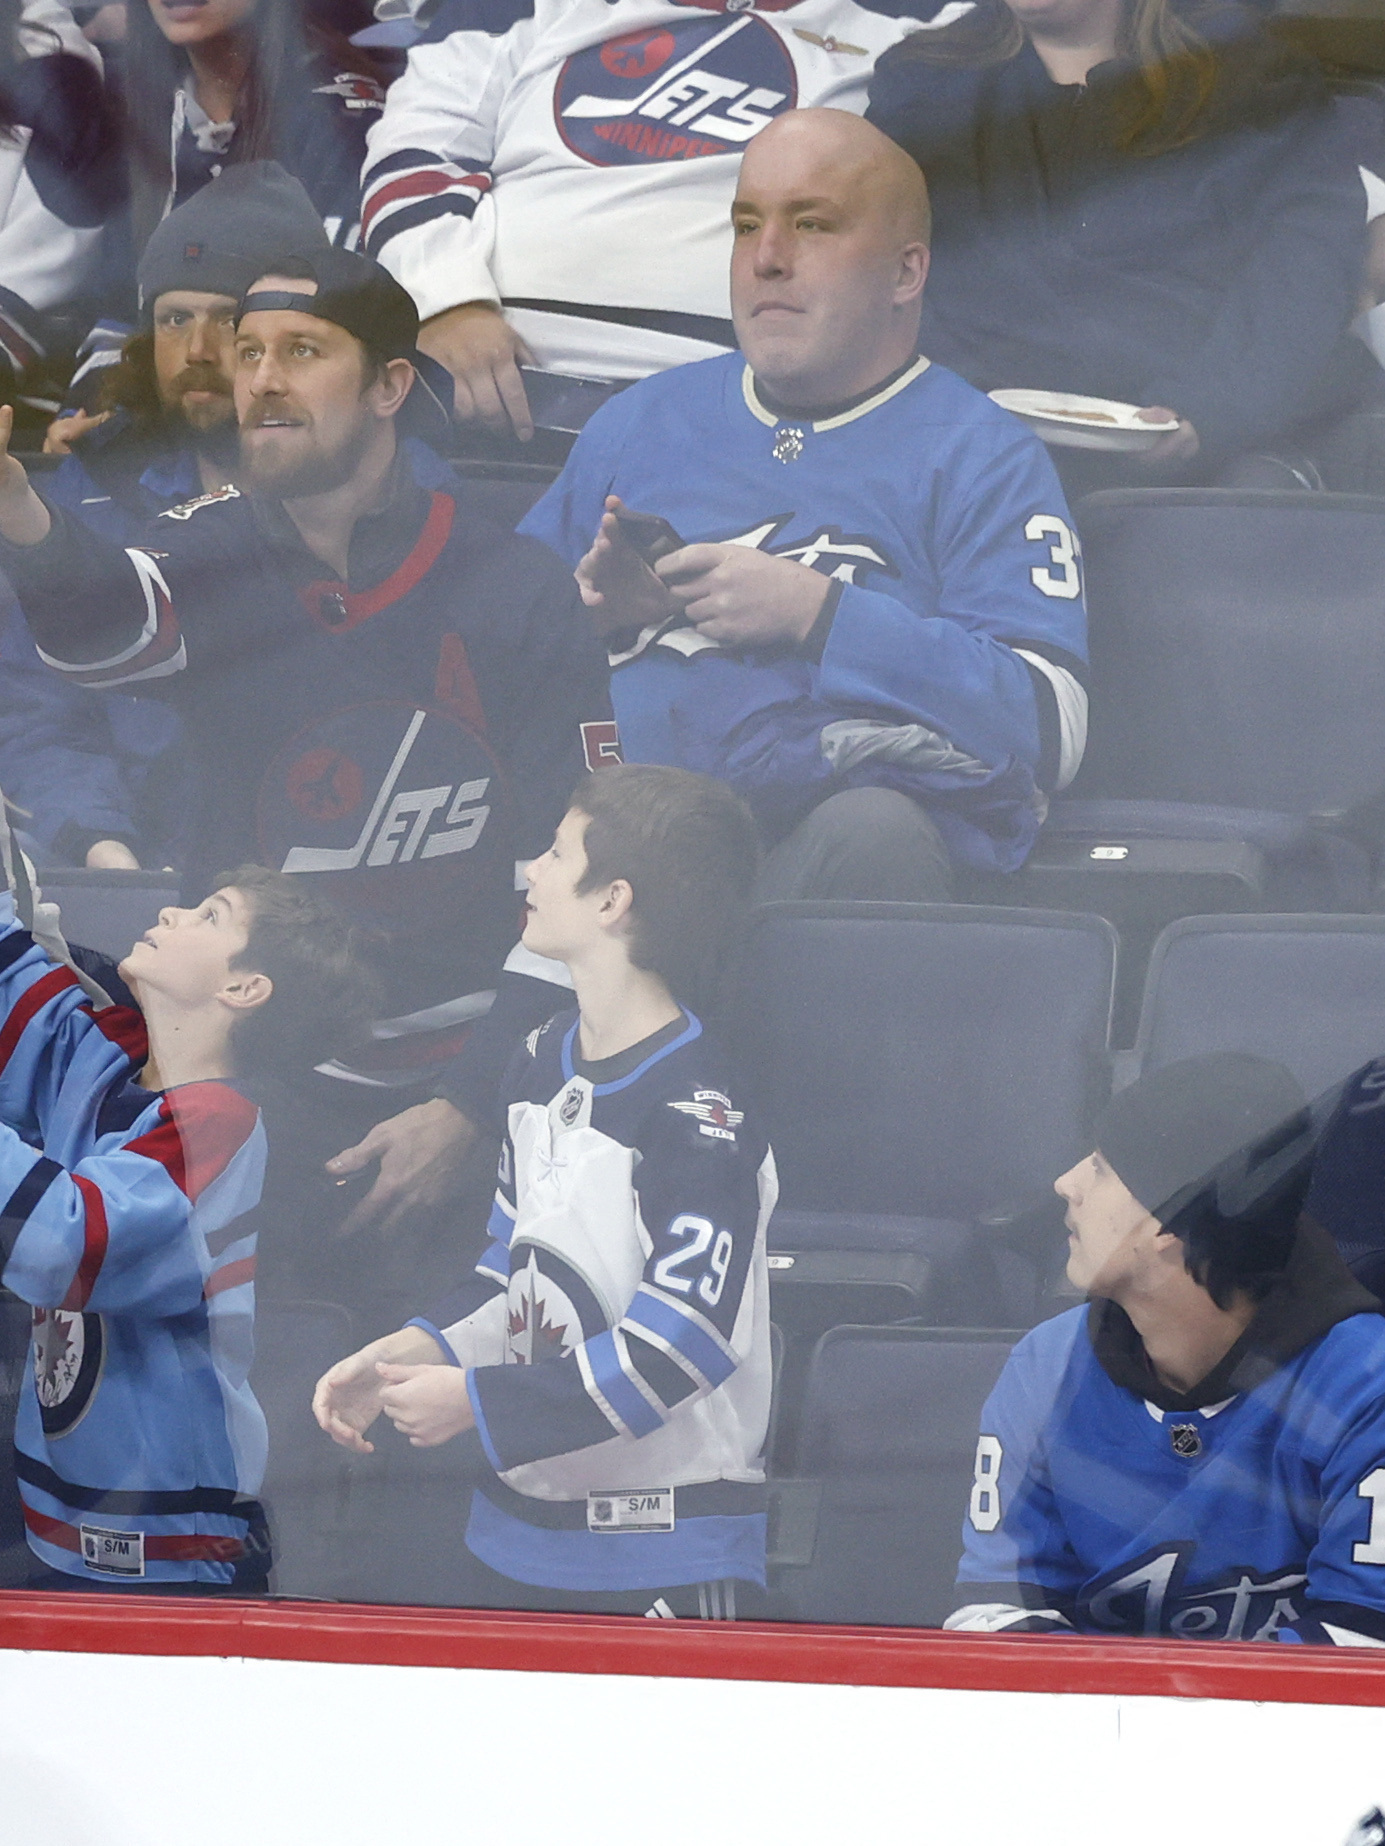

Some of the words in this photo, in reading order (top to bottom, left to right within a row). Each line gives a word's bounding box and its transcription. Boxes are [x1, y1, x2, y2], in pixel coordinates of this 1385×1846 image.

[561, 15, 787, 143] JETS
[1024, 513, 1082, 600] 3
[280, 710, 491, 874] JETS
[654, 1211, 733, 1307] 29
[628, 1496, 661, 1511] S/M
[968, 1433, 1004, 1533] 8
[104, 1539, 130, 1556] S/M
